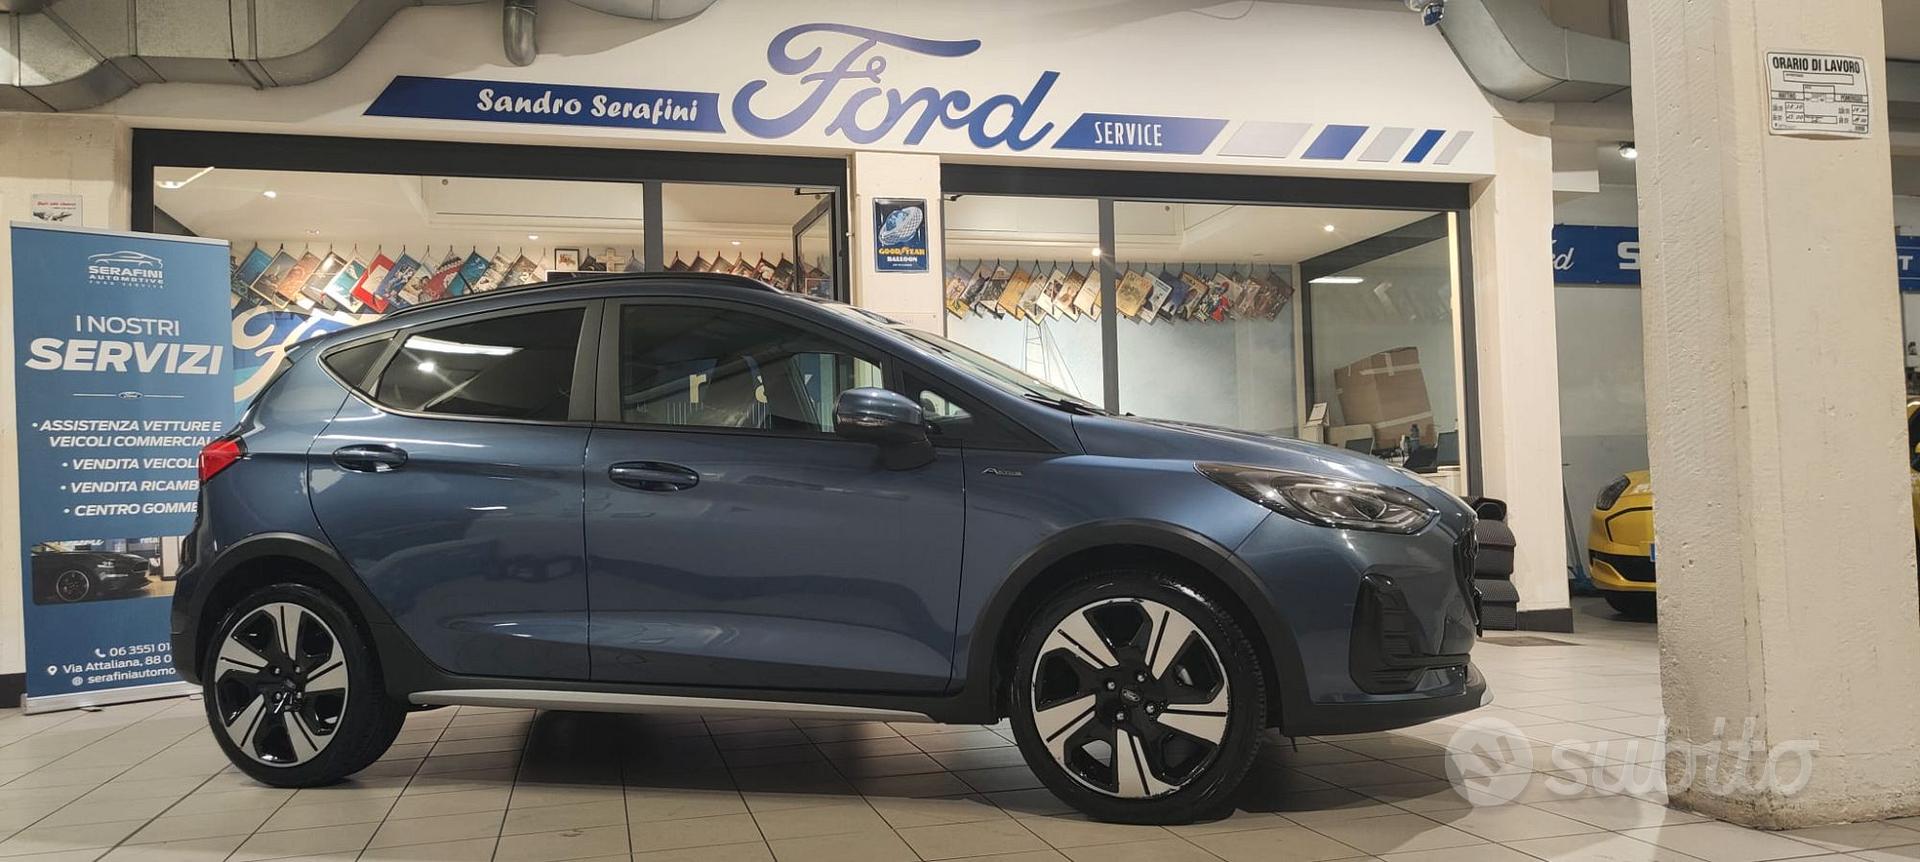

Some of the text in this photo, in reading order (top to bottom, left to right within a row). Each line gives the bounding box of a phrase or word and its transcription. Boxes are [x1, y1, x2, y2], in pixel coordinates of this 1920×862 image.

[1772, 56, 1860, 74] ORARIO DI LAVORO
[731, 22, 1061, 151] Ford
[477, 88, 698, 125] Sandro Serafini
[1094, 121, 1162, 147] SERVICE
[887, 255, 918, 263] BALLOON
[88, 265, 164, 279] SERAFINI
[89, 274, 164, 285] AUTOMOTIVE
[76, 315, 180, 337] I NOSTRI
[25, 337, 224, 375] SERVIZI
[39, 419, 222, 432] ASSISTENZA VETTURE E
[50, 436, 218, 447] VEICOLI COMMERCIAL
[72, 457, 199, 470] VENDITA VEICOLI
[71, 479, 199, 493] VENDITA RICAMB
[74, 503, 140, 516] CENTRO
[109, 642, 173, 657] 06 3551 01
[63, 664, 83, 674] Via
[85, 657, 143, 672] Attaliana,
[145, 654, 161, 665] 88
[87, 666, 176, 684] serafiniautomo
